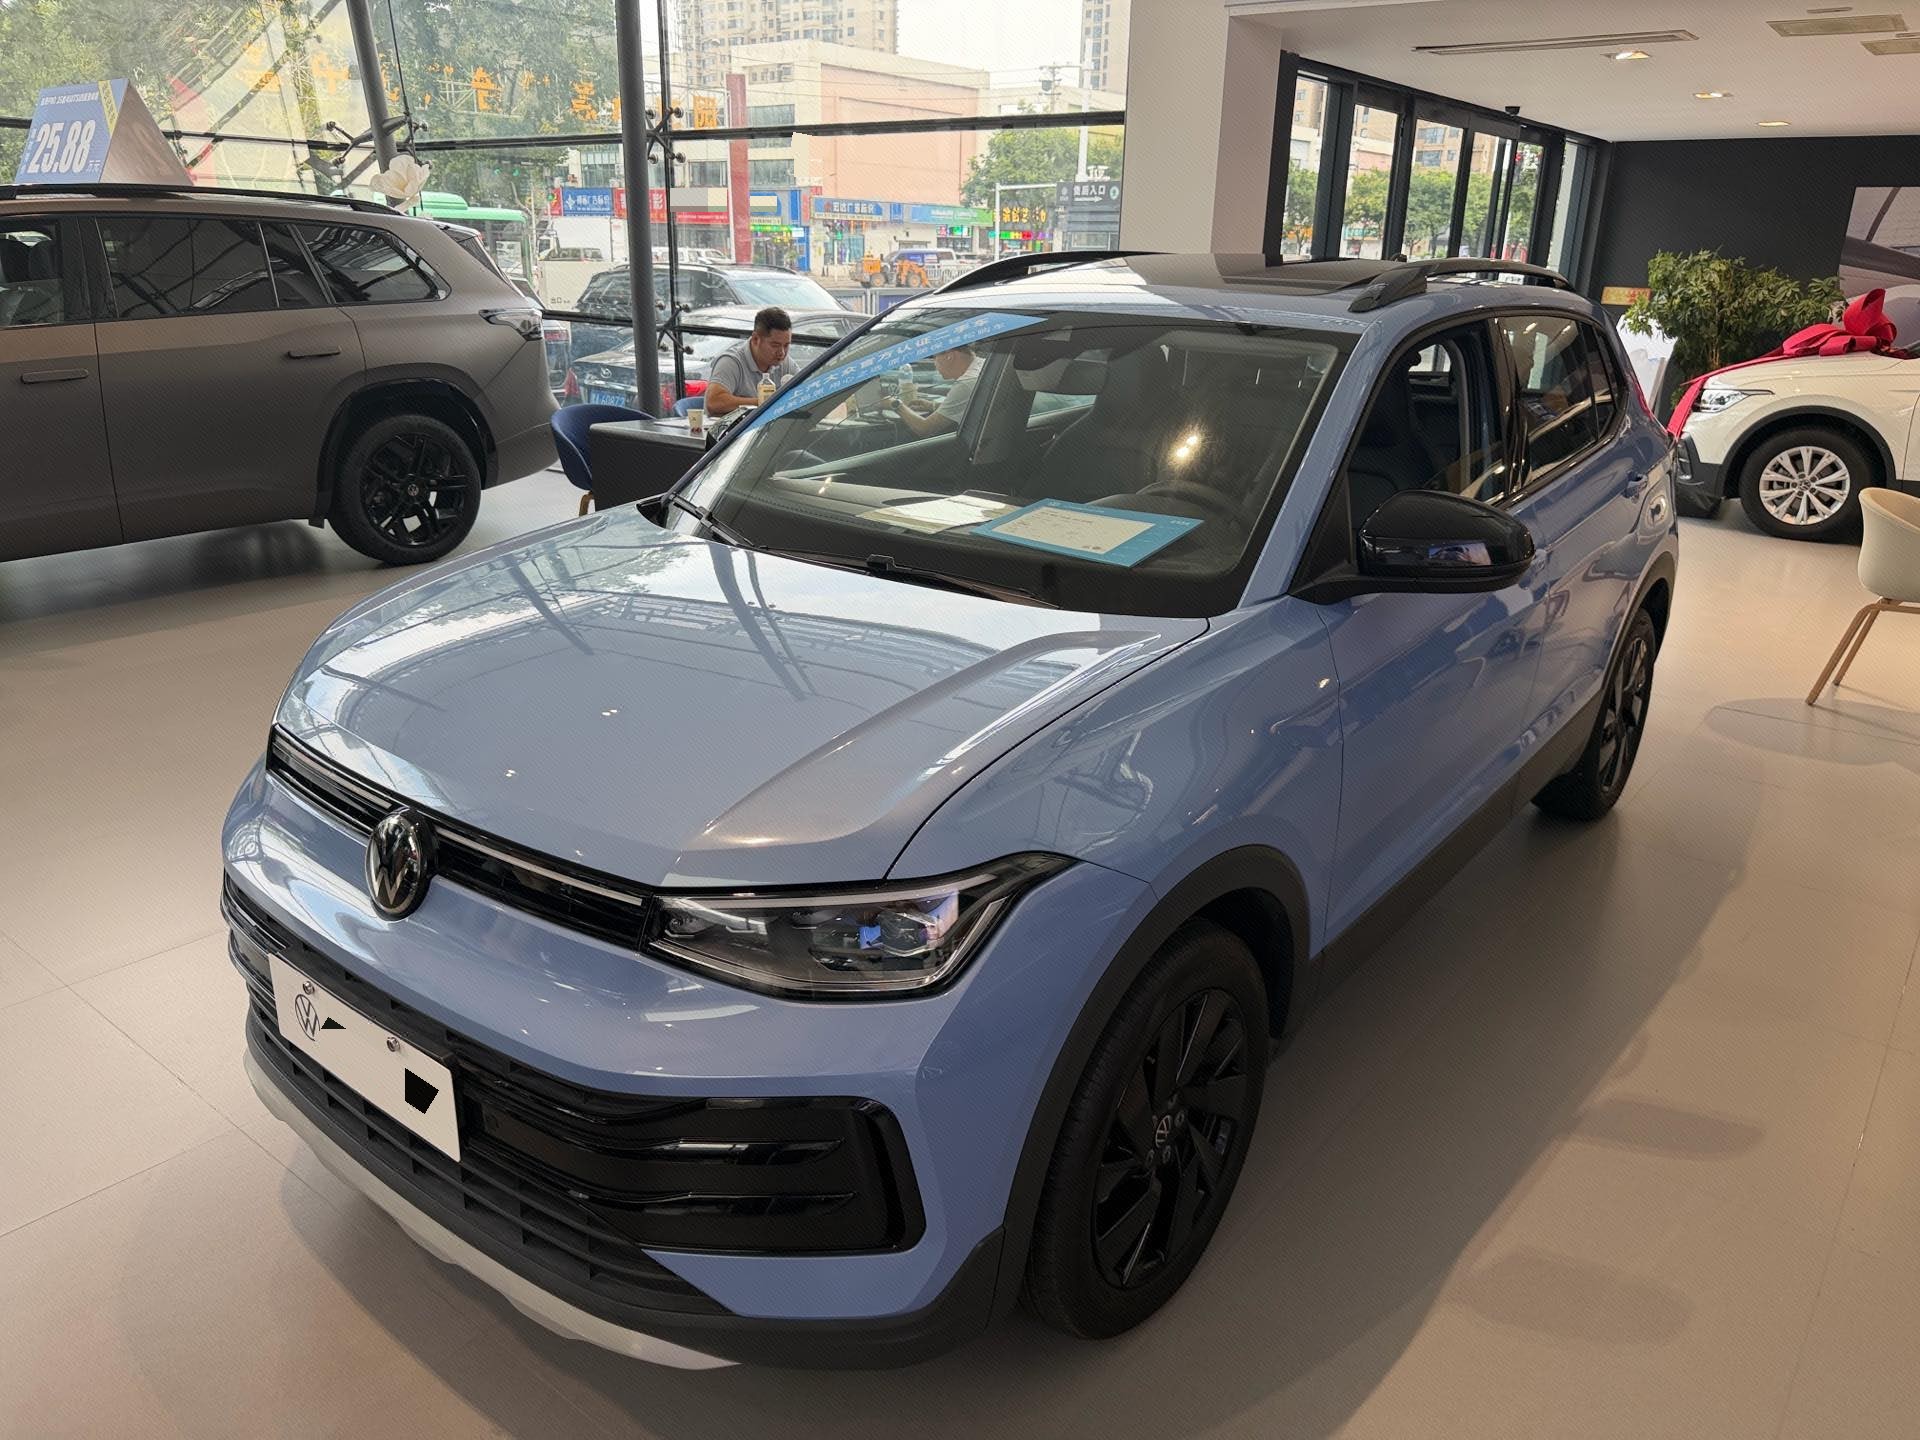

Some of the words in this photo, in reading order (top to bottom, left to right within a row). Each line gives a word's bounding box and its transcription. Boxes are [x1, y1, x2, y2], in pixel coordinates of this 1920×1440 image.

[28, 120, 97, 174] 25.88
[790, 318, 989, 400] 上汽大众官方认证二手车
